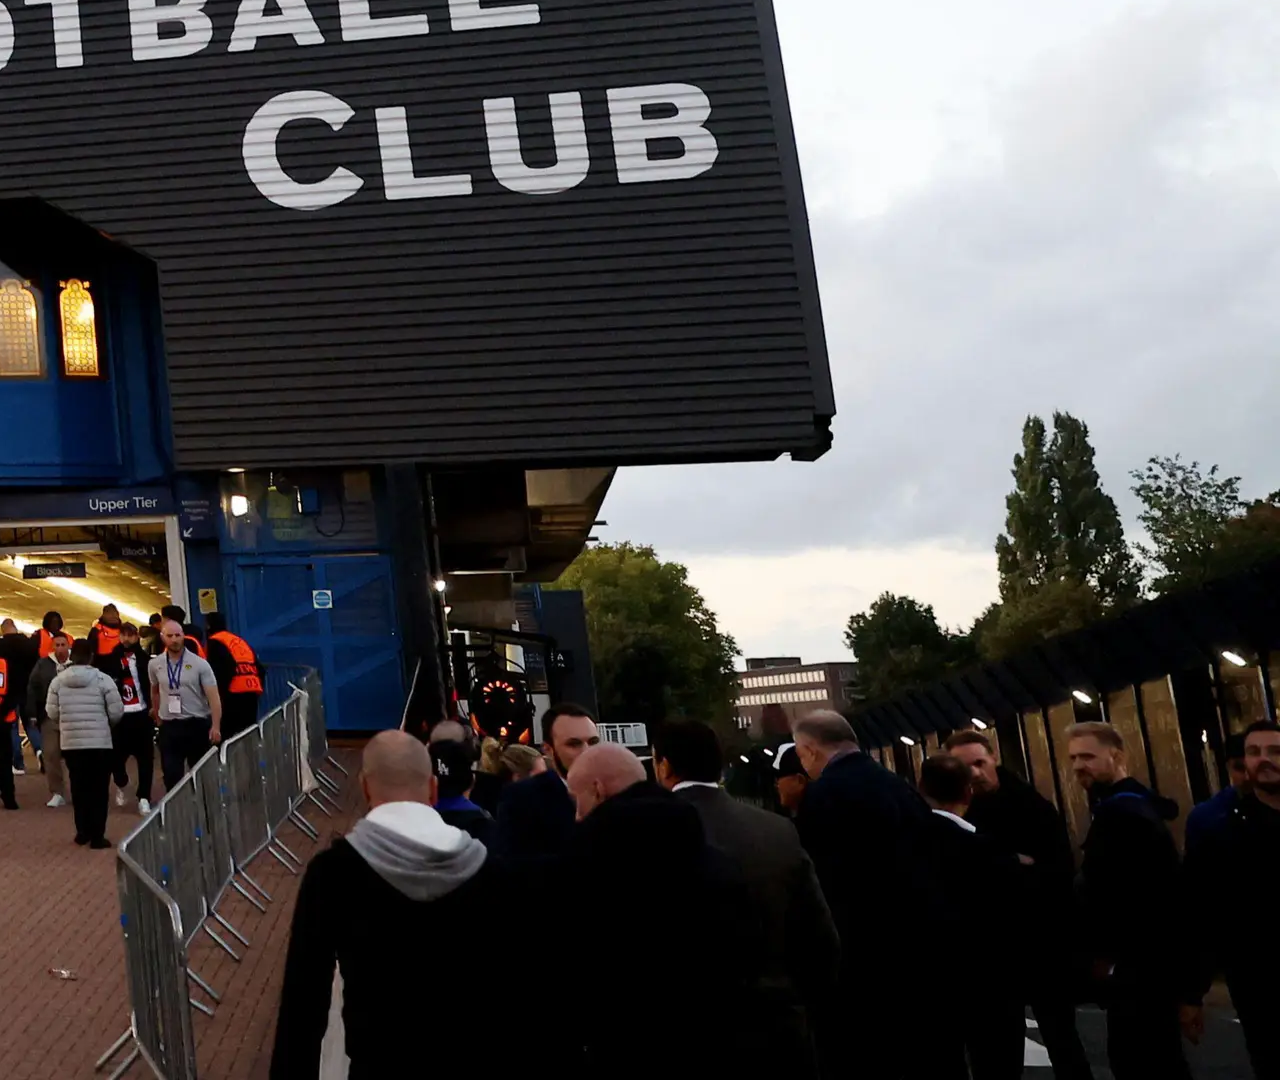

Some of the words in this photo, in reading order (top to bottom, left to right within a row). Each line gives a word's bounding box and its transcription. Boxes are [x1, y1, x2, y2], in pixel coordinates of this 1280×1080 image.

[242, 83, 719, 210] CLUB
[89, 498, 130, 512] Upper
[133, 496, 157, 508] Tier
[36, 566, 62, 576] Block
